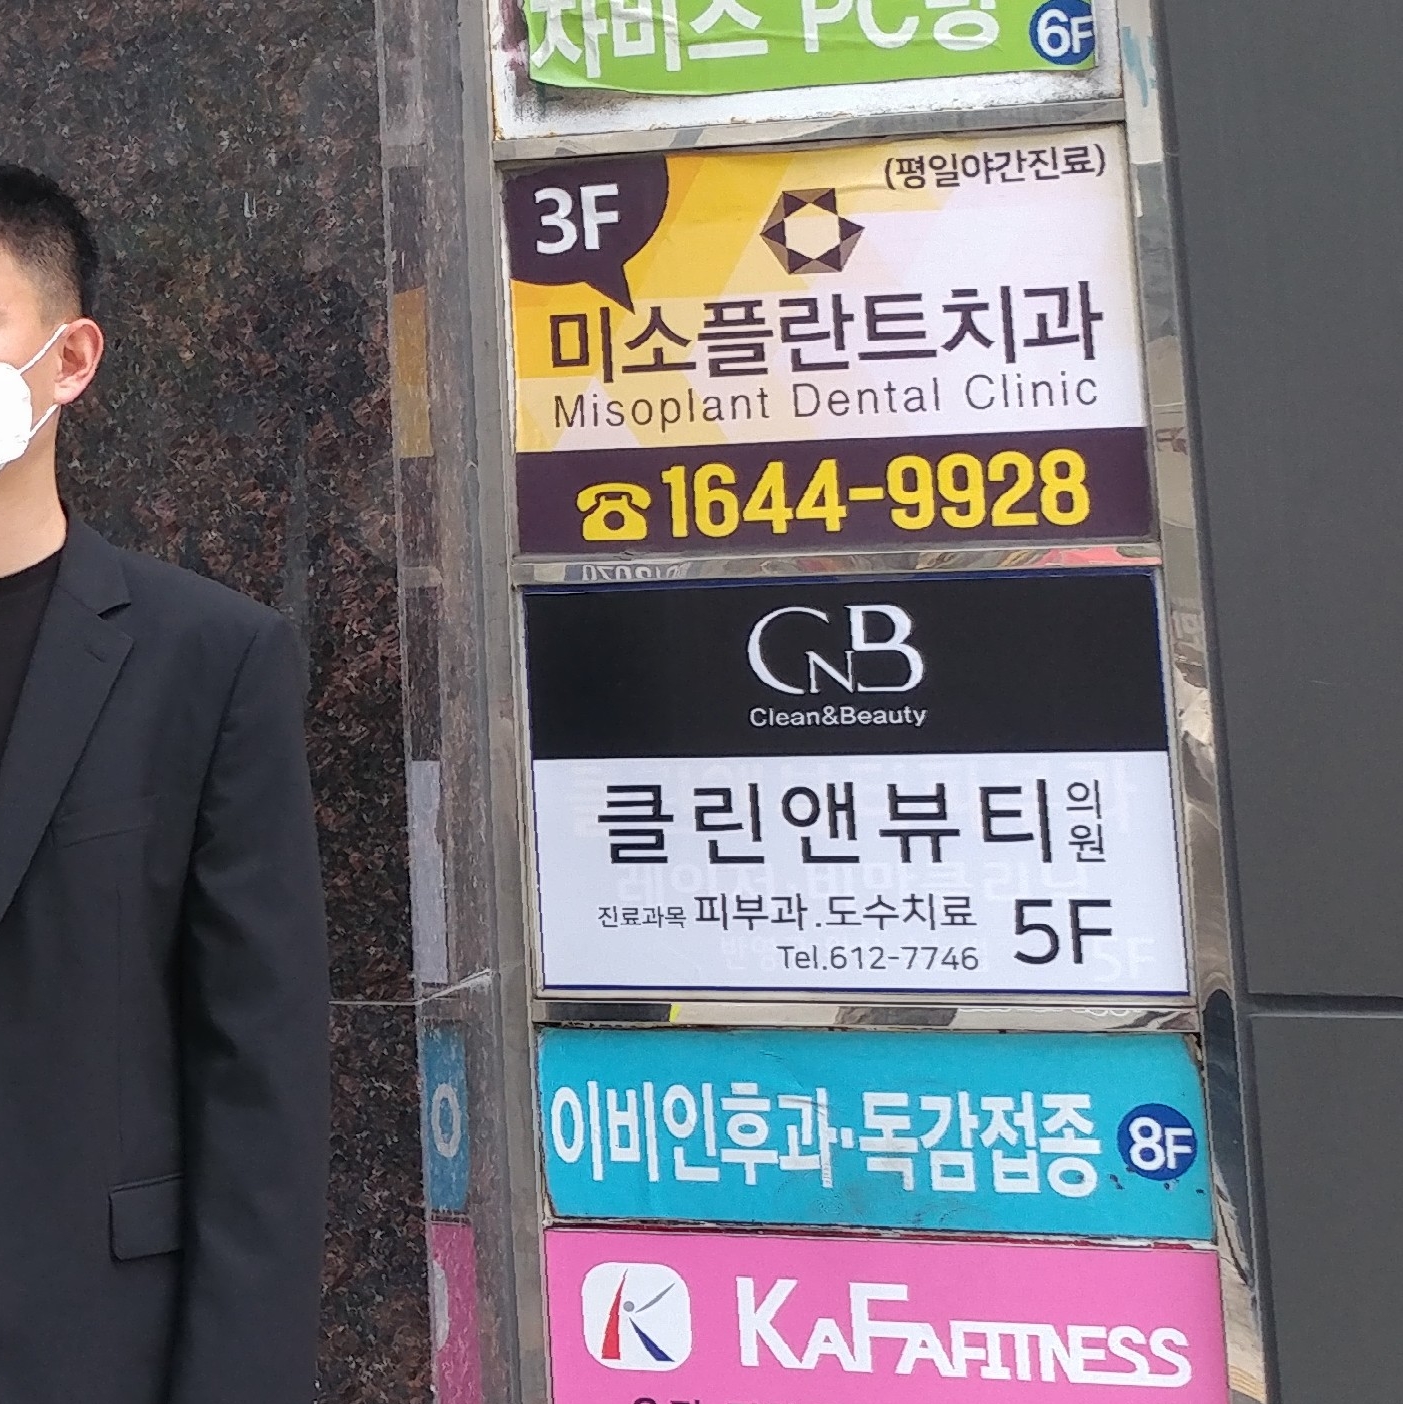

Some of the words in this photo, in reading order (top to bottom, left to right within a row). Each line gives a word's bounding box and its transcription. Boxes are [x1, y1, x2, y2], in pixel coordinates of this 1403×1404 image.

[1037, 8, 1094, 58] 6F
[884, 142, 1107, 191] (평일야간진료)
[534, 183, 619, 255] 3F
[549, 279, 1103, 385] 미소플란트치과
[554, 387, 770, 434] Misoplant
[792, 377, 940, 418] Dental
[965, 370, 1098, 410] Clinic
[662, 448, 1090, 537] 1644-9928
[749, 705, 927, 730] Clean&Beauty
[597, 778, 1052, 865] 클린앤뷰티
[1066, 779, 1106, 863] 의원
[597, 905, 687, 930] 진료과목
[1014, 899, 1112, 965] 5F
[776, 944, 979, 972] Tel.612-7746
[1129, 1117, 1192, 1171] 8F
